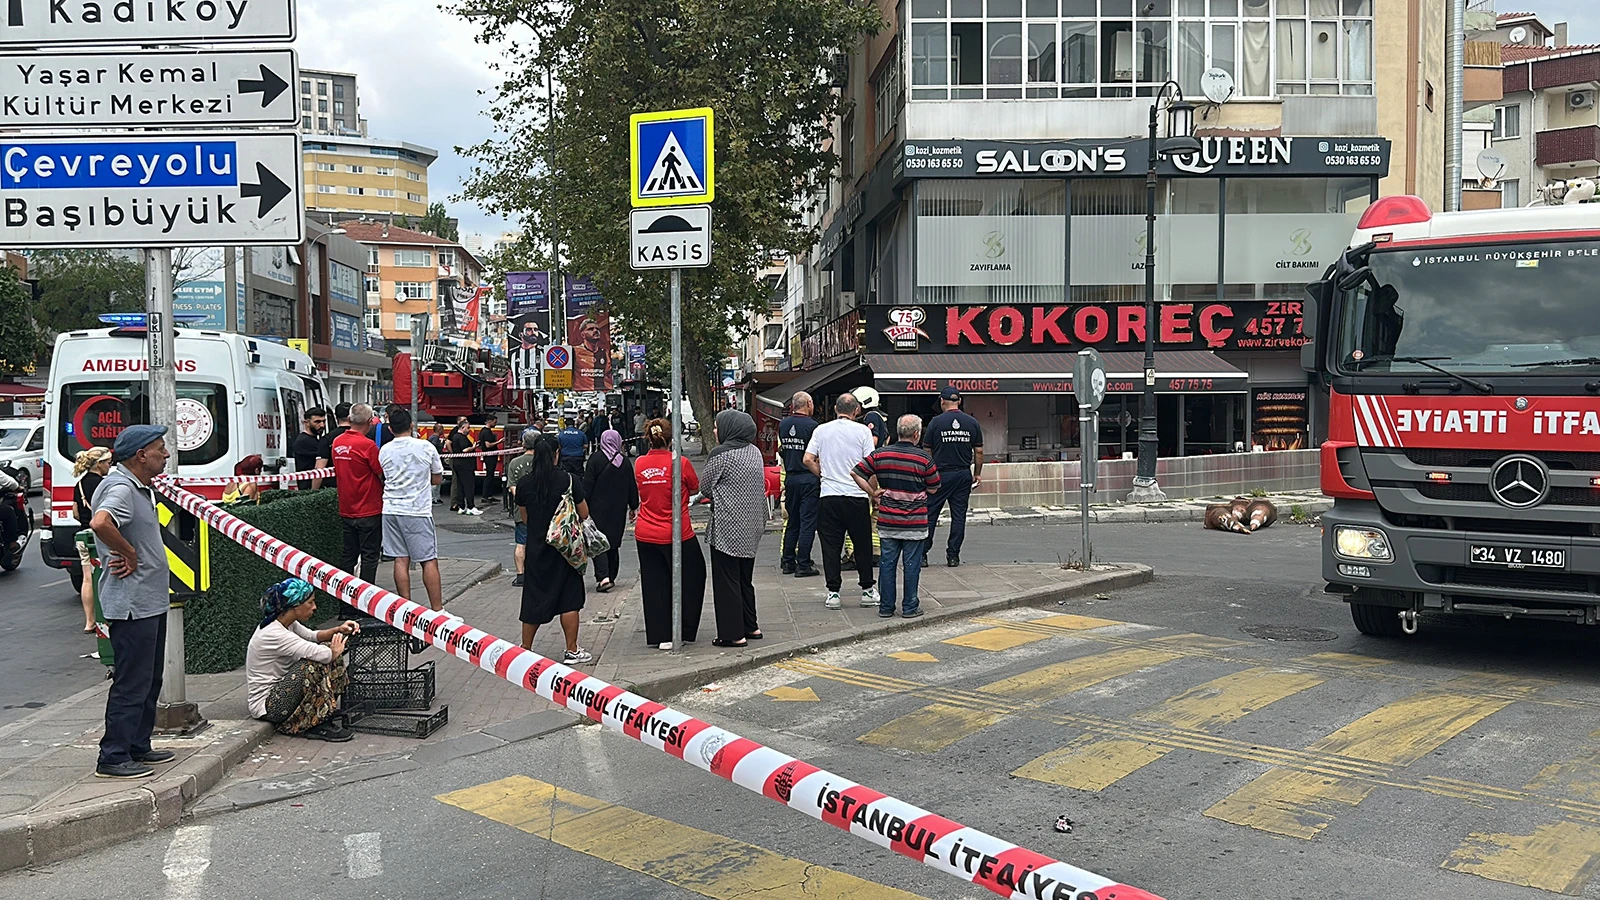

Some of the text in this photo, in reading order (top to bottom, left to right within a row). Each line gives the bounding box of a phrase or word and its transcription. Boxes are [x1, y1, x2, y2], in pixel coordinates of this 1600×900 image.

[17, 62, 217, 87] Yaşar Kemal
[4, 94, 232, 116] Kültür Merkezi
[5, 145, 231, 185] Çevreyolu
[906, 158, 963, 168] 0530 163 65 50
[976, 147, 1126, 173] SALOON'S
[1325, 156, 1381, 165] 0530 163 65 50
[5, 195, 236, 233] Başıbüyük
[638, 240, 703, 262] KASİS
[1424, 254, 1480, 264] İSTANBUL
[970, 263, 1011, 271] ZAYIFLAMA
[1275, 259, 1291, 269] CİLT
[898, 312, 912, 323] 75
[946, 303, 1234, 348] KOKOREÇ
[1245, 318, 1285, 335] 457
[82, 359, 197, 372] AMBULNS
[1169, 379, 1185, 390] 457
[1187, 379, 1199, 390] 75
[1201, 379, 1213, 390] 75
[98, 410, 122, 423] ACİL
[1480, 547, 1562, 565] 34 VZ 1480
[402, 607, 484, 658] İSTANBUL İTFAİYESİ
[550, 671, 688, 749] İSTANBUL İTFAİYESİ
[817, 782, 940, 860] İSTANBUL
